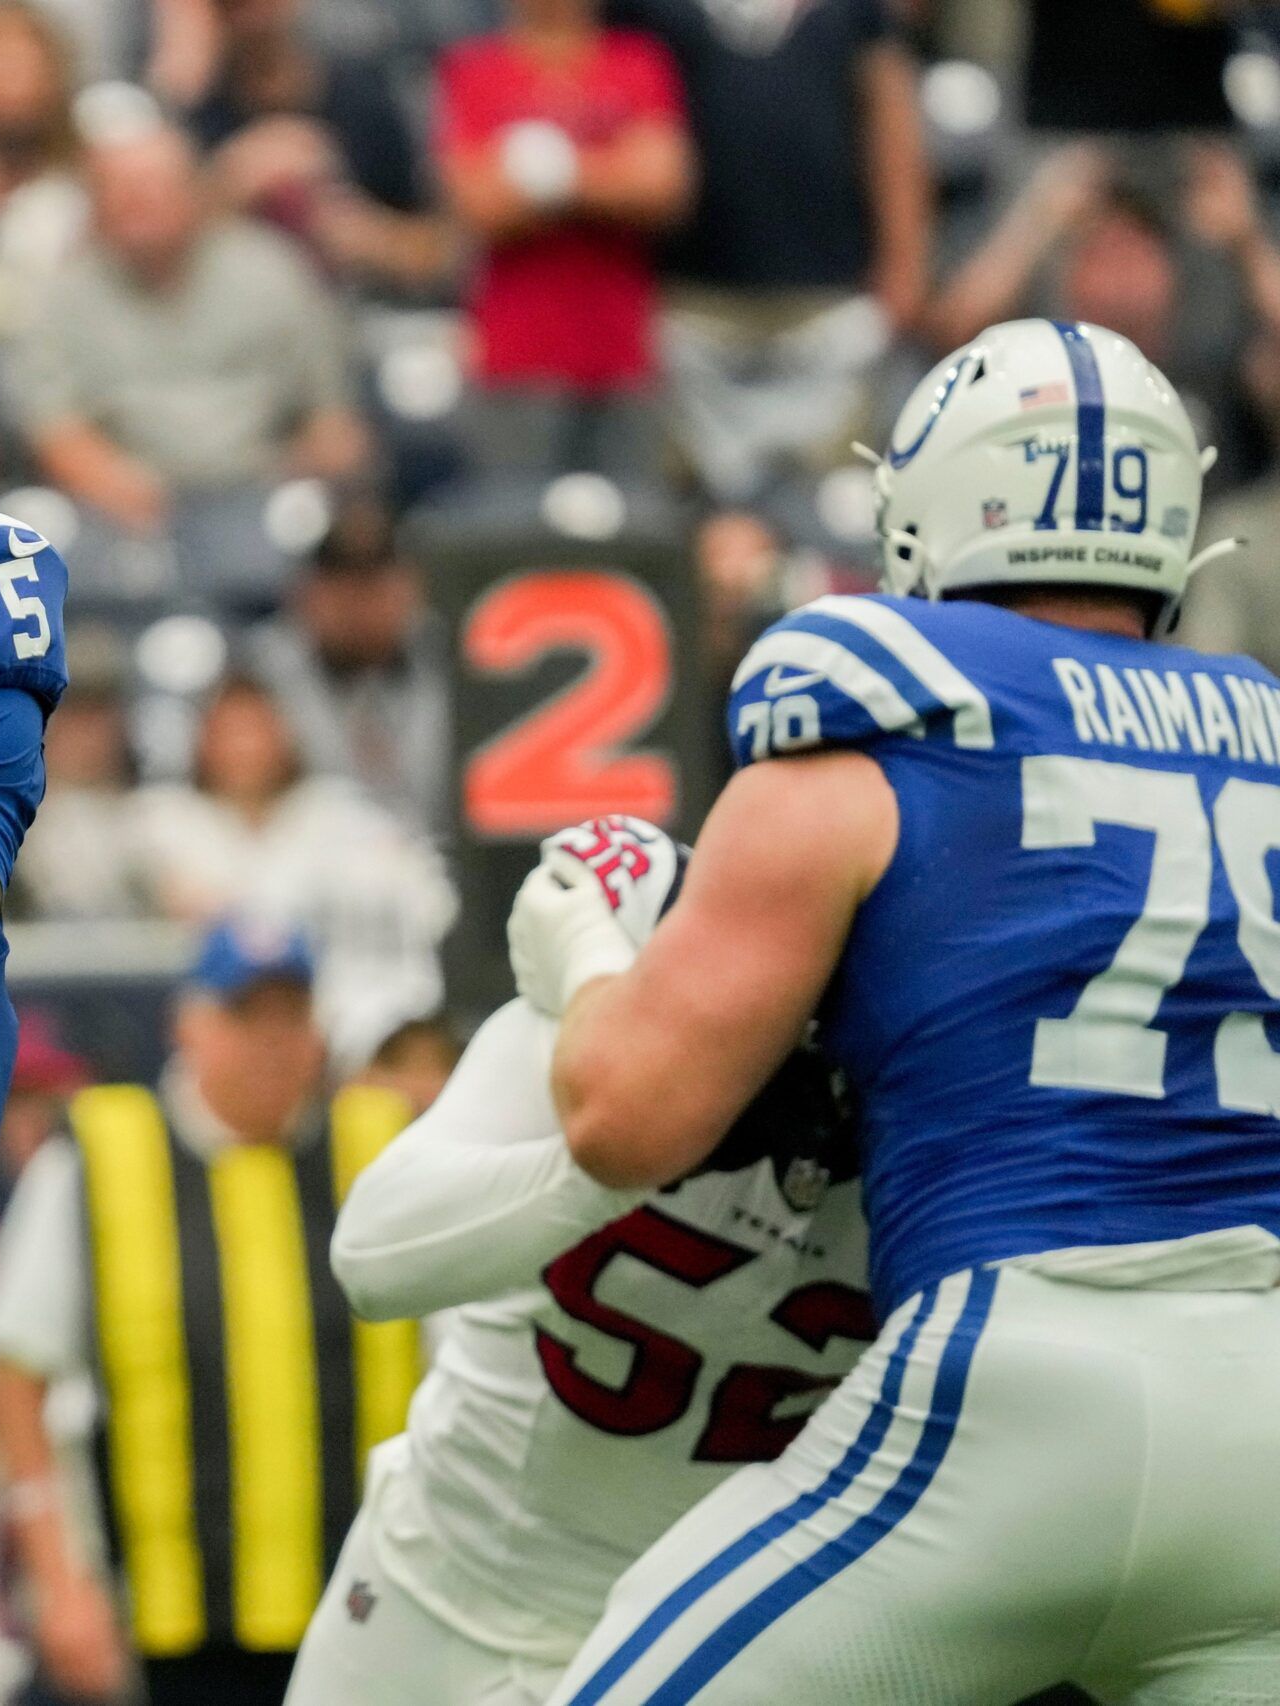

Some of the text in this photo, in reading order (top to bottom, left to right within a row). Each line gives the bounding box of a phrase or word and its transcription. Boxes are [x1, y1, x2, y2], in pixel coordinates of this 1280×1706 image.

[1007, 547, 1088, 565] INSPIRE
[465, 570, 677, 836] 2
[531, 1203, 883, 1463] 52
